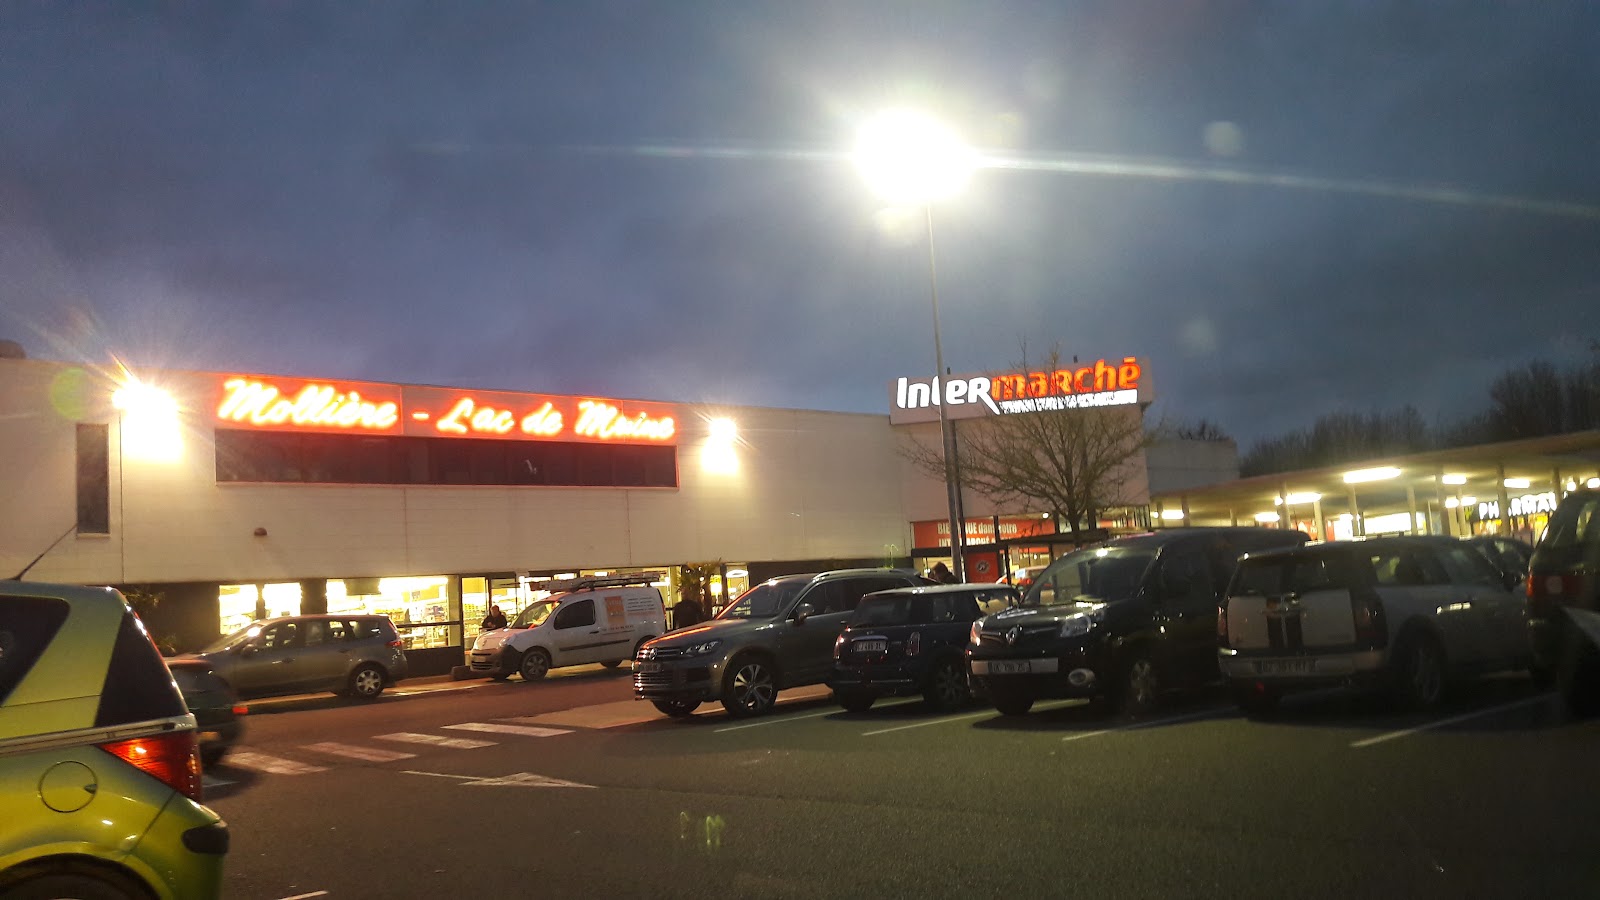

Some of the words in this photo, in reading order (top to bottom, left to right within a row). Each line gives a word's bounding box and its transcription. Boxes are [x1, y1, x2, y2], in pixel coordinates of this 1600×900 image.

[217, 378, 397, 426] Mollière
[437, 397, 514, 434] Lac
[523, 401, 563, 435] de
[575, 400, 675, 439] Maine
[937, 522, 977, 534] BIENUE
